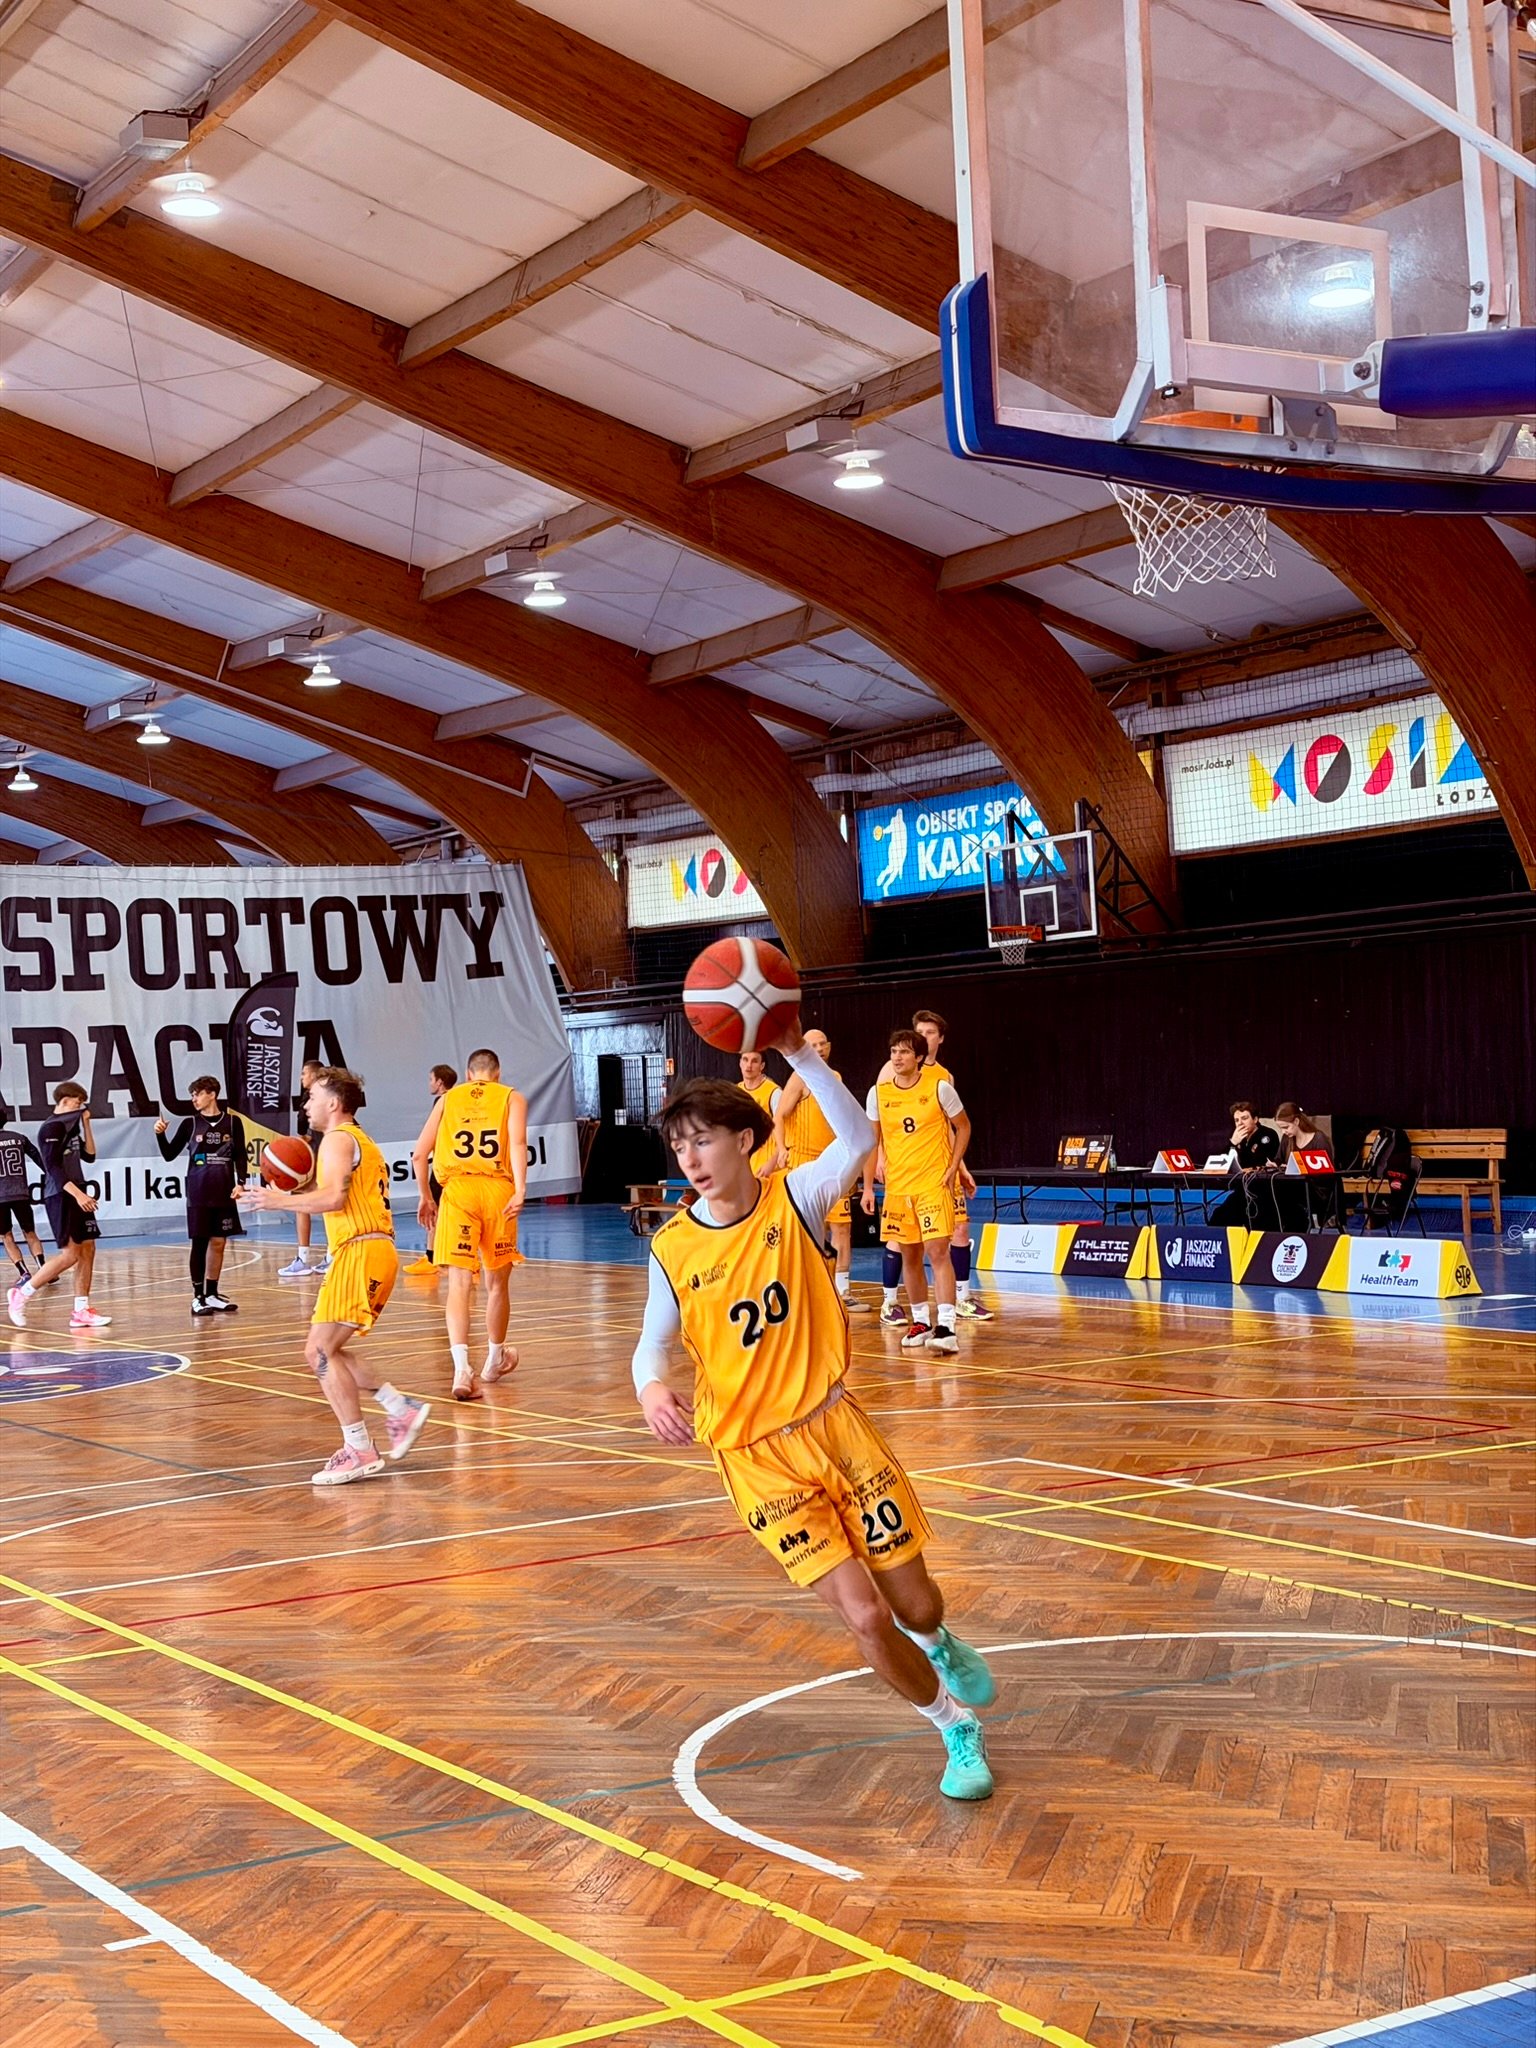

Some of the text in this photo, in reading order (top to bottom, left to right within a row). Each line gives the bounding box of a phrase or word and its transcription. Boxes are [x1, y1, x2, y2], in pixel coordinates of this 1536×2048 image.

[1181, 755, 1235, 774] mosir.lodz.pl
[915, 804, 979, 838] OBIEKT
[0, 892, 506, 992] SPORTOWY
[262, 1044, 281, 1109] JASZCZAK
[903, 1117, 915, 1133] 8
[454, 1129, 500, 1159] 35
[923, 1216, 931, 1228] 8
[1074, 1239, 1130, 1251] ATHLETIC
[1185, 1239, 1223, 1254] JASZCZAK
[1072, 1251, 1129, 1263] TRAINING
[1184, 1252, 1217, 1269] FINANSE
[1360, 1273, 1419, 1287] HealthTeam
[729, 1281, 790, 1348] 20
[861, 1499, 903, 1544] 20
